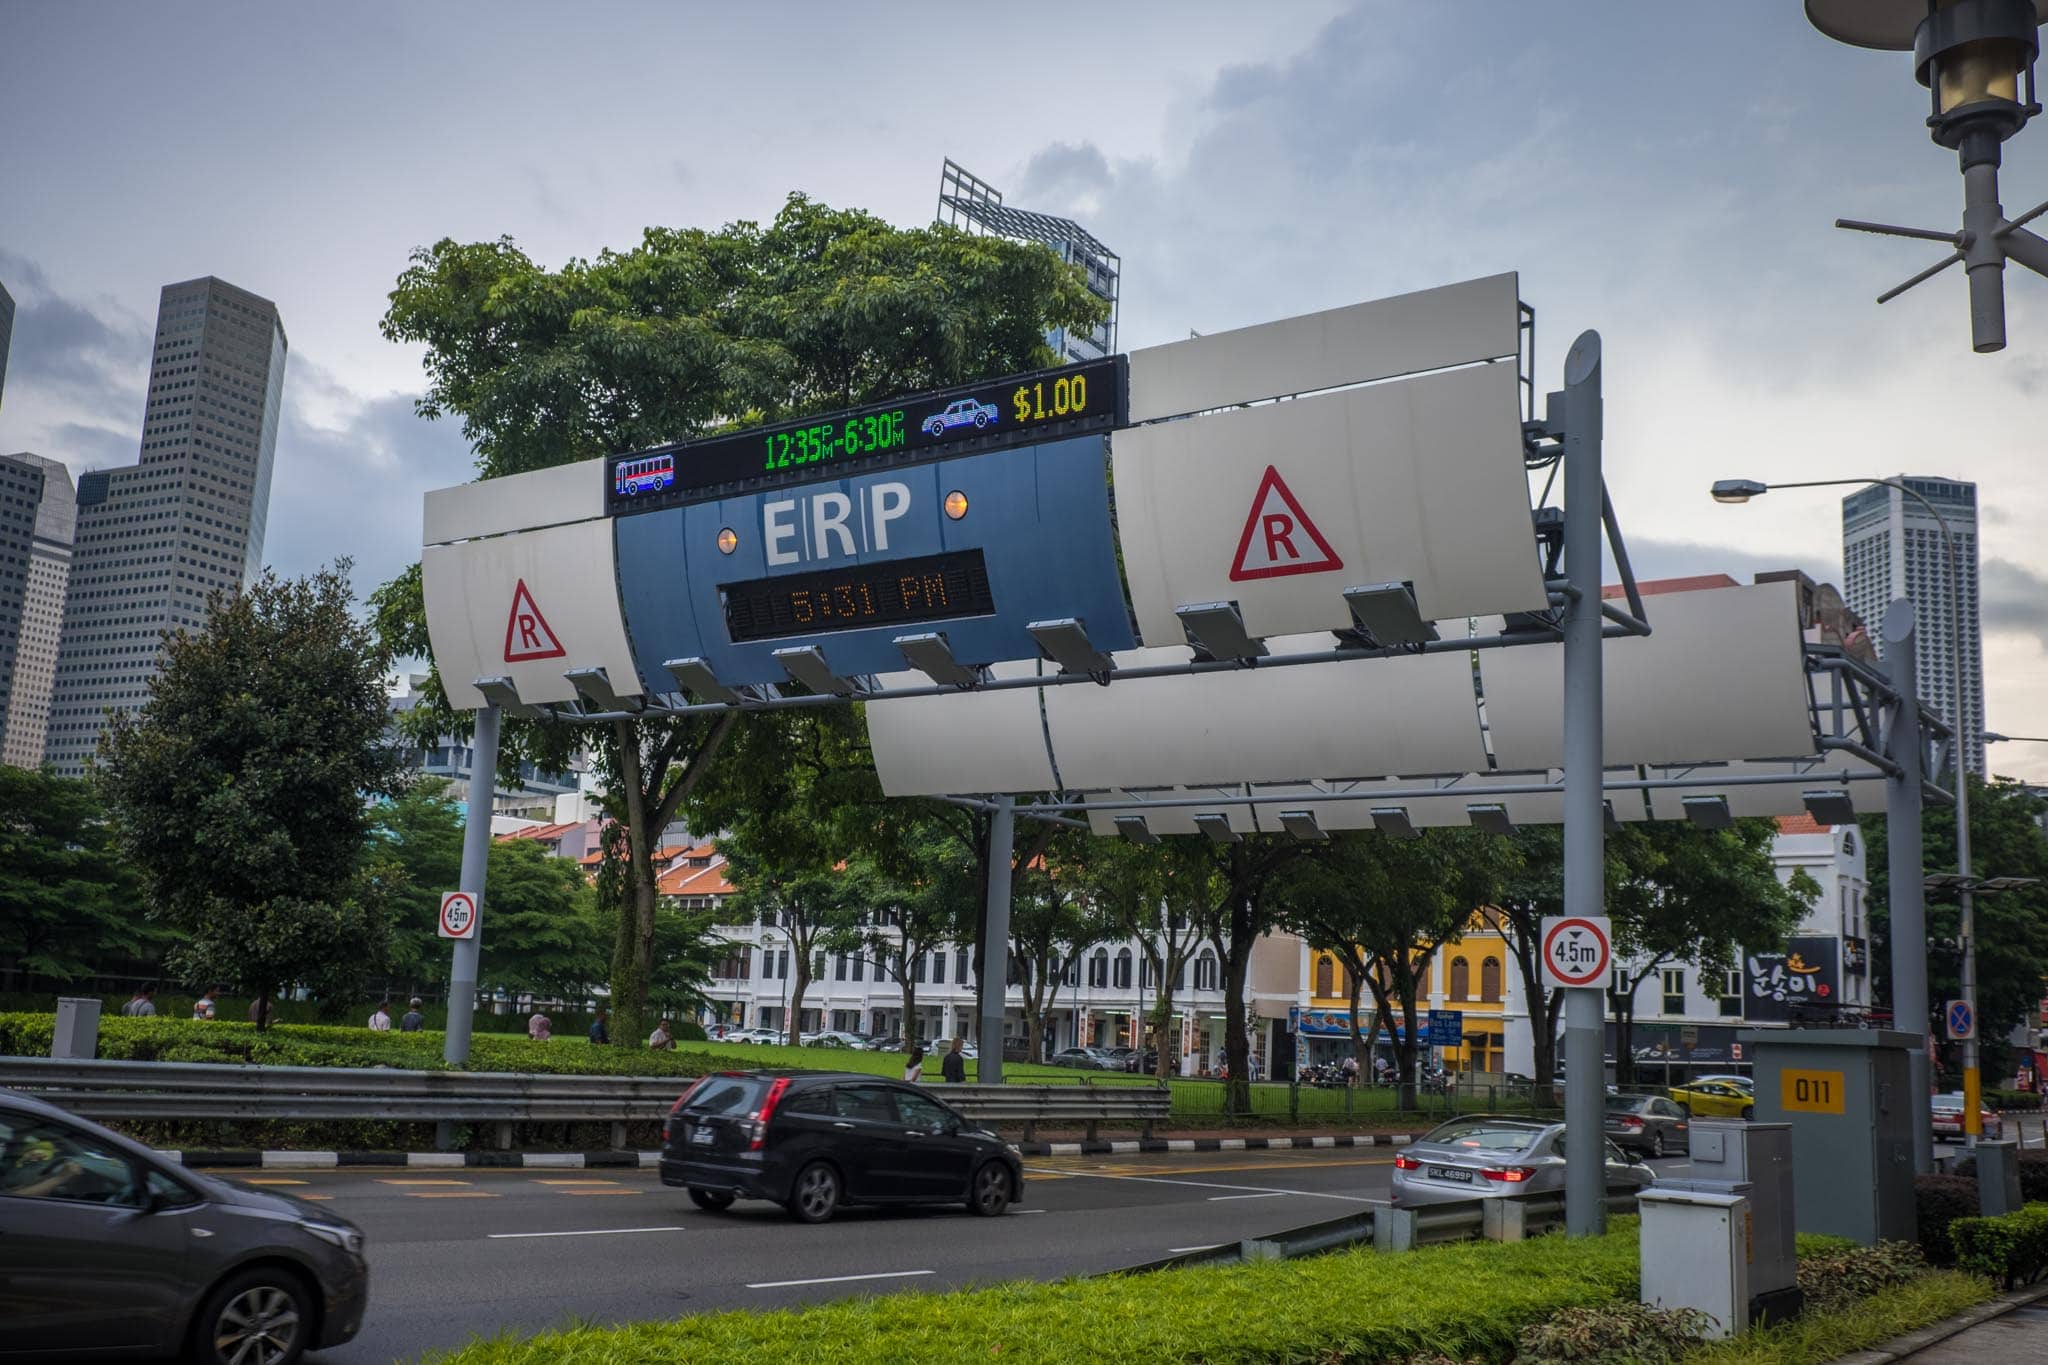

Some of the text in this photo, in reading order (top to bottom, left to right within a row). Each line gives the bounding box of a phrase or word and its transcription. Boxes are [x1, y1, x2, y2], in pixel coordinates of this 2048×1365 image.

[1013, 375, 1087, 422] $1.00
[763, 482, 911, 567] ERP
[1262, 513, 1300, 561] R
[791, 573, 948, 623] 5:31 PM
[518, 614, 542, 649] R
[1555, 941, 1596, 962] 4.5m
[1796, 1078, 1830, 1104] 011
